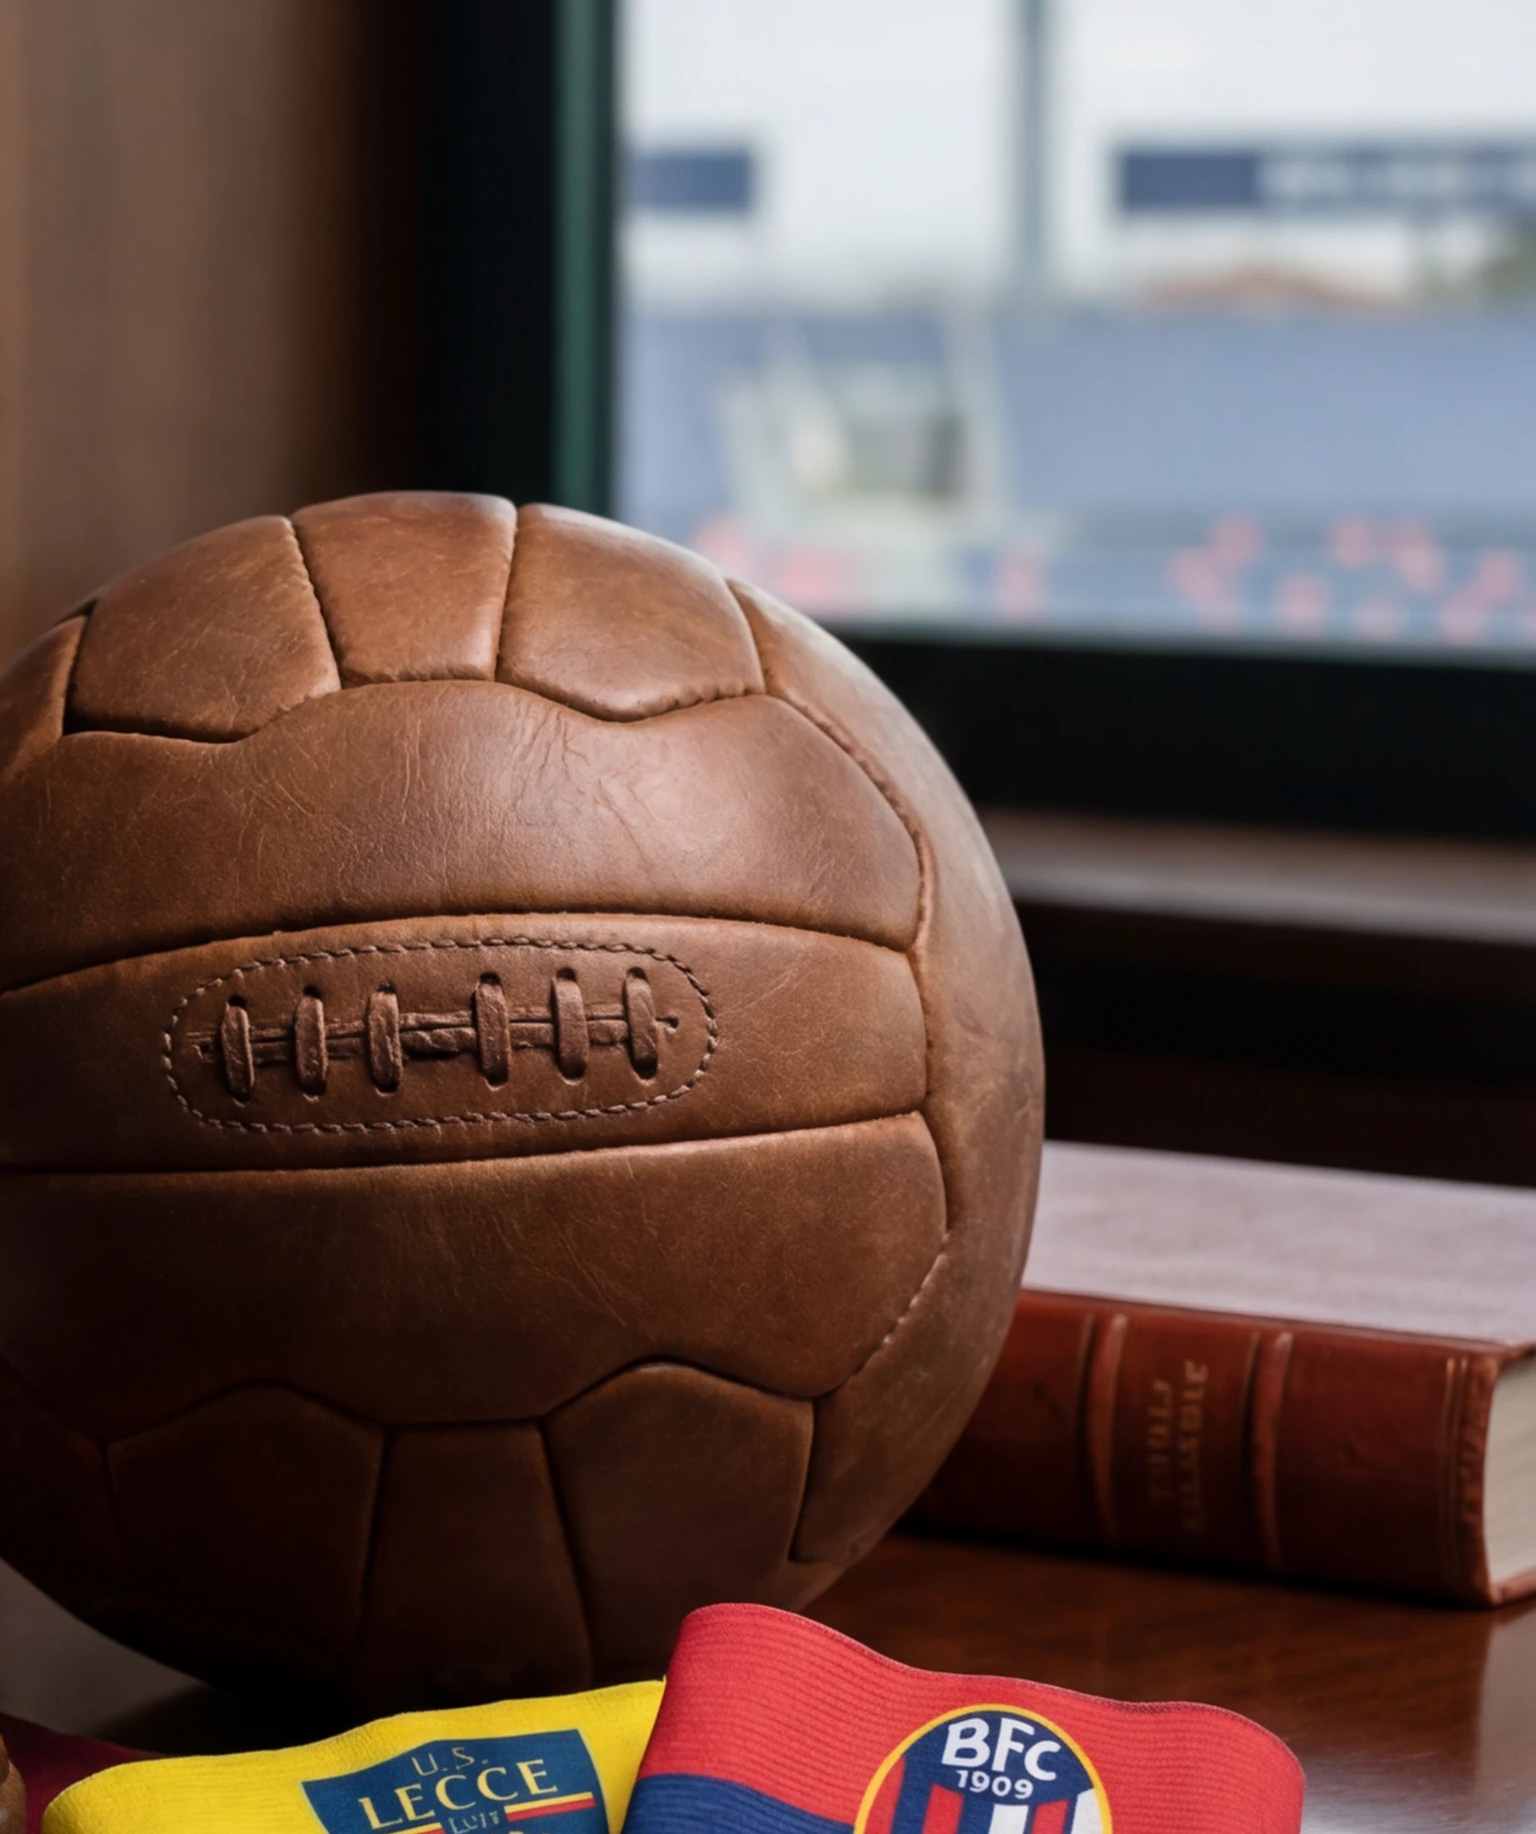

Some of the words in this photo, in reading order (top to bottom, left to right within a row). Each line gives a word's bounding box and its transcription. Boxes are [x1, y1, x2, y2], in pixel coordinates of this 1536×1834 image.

[941, 1717, 1062, 1781] BFC
[358, 1759, 559, 1830] LECCE
[956, 1769, 1034, 1799] 1909
